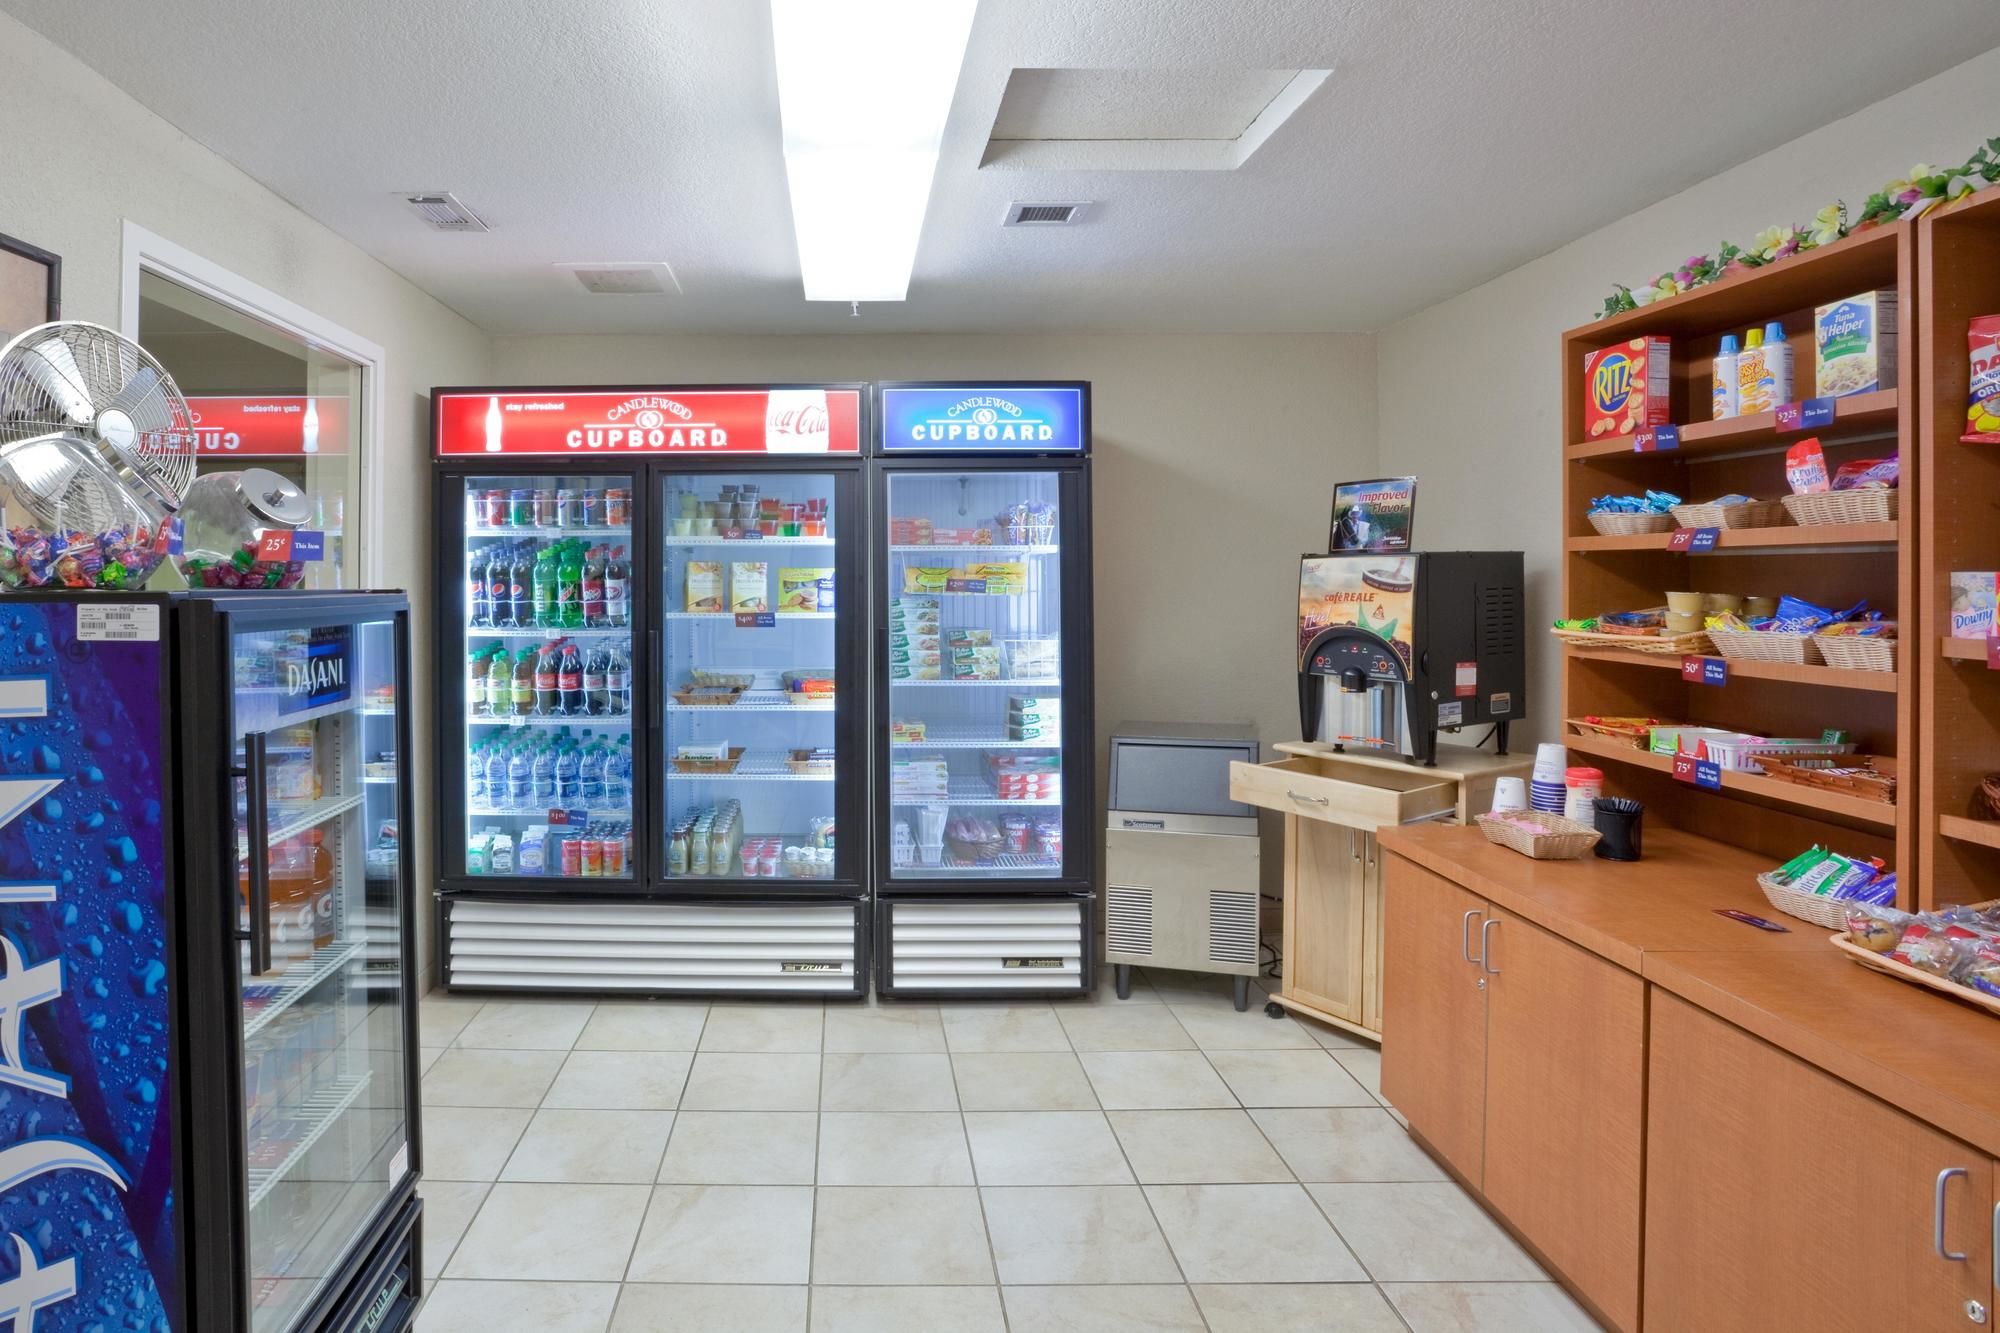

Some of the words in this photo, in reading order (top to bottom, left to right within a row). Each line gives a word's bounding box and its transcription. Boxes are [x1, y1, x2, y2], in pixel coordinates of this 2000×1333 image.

[1835, 312, 1855, 323] Tuna
[1828, 319, 1864, 337] Helper
[1596, 360, 1632, 408] RITZ
[505, 403, 523, 412] stay
[524, 402, 565, 411] refreshed
[607, 397, 692, 421] CANDLEWOOD
[948, 397, 1022, 417] CANDLEWOOD
[566, 429, 727, 448] CUPBOARD
[912, 424, 1053, 441] CUPBOARD
[1359, 487, 1409, 504] Improved
[1372, 502, 1405, 514] Flavor
[266, 538, 286, 551] 25¢
[1954, 609, 1993, 629] Downy
[289, 657, 343, 697] DASANI
